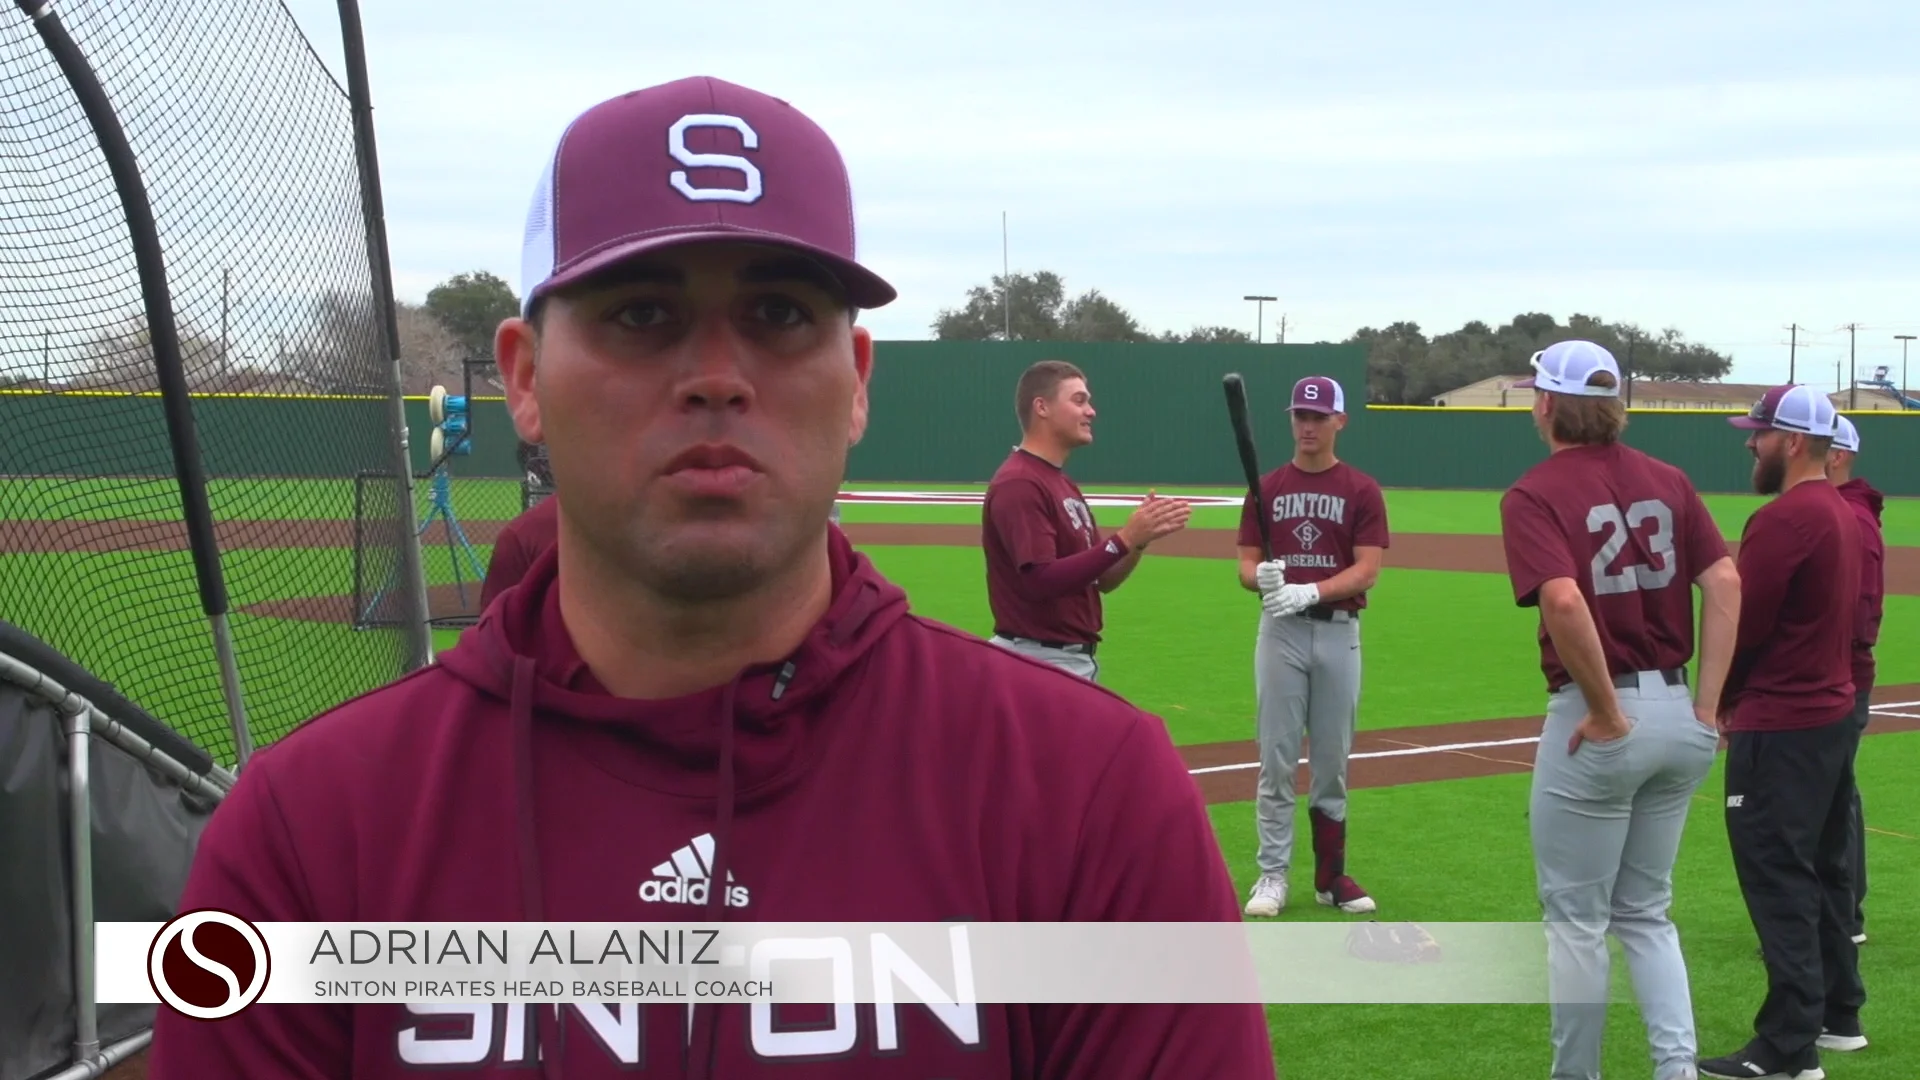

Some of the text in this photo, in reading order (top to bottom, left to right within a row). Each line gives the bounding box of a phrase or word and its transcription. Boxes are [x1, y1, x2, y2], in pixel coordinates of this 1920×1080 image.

[668, 113, 762, 204] S
[1304, 384, 1319, 400] S
[1272, 492, 1346, 525] SINTON
[1302, 525, 1313, 542] S
[1585, 499, 1677, 596] 23
[638, 876, 750, 908] adids
